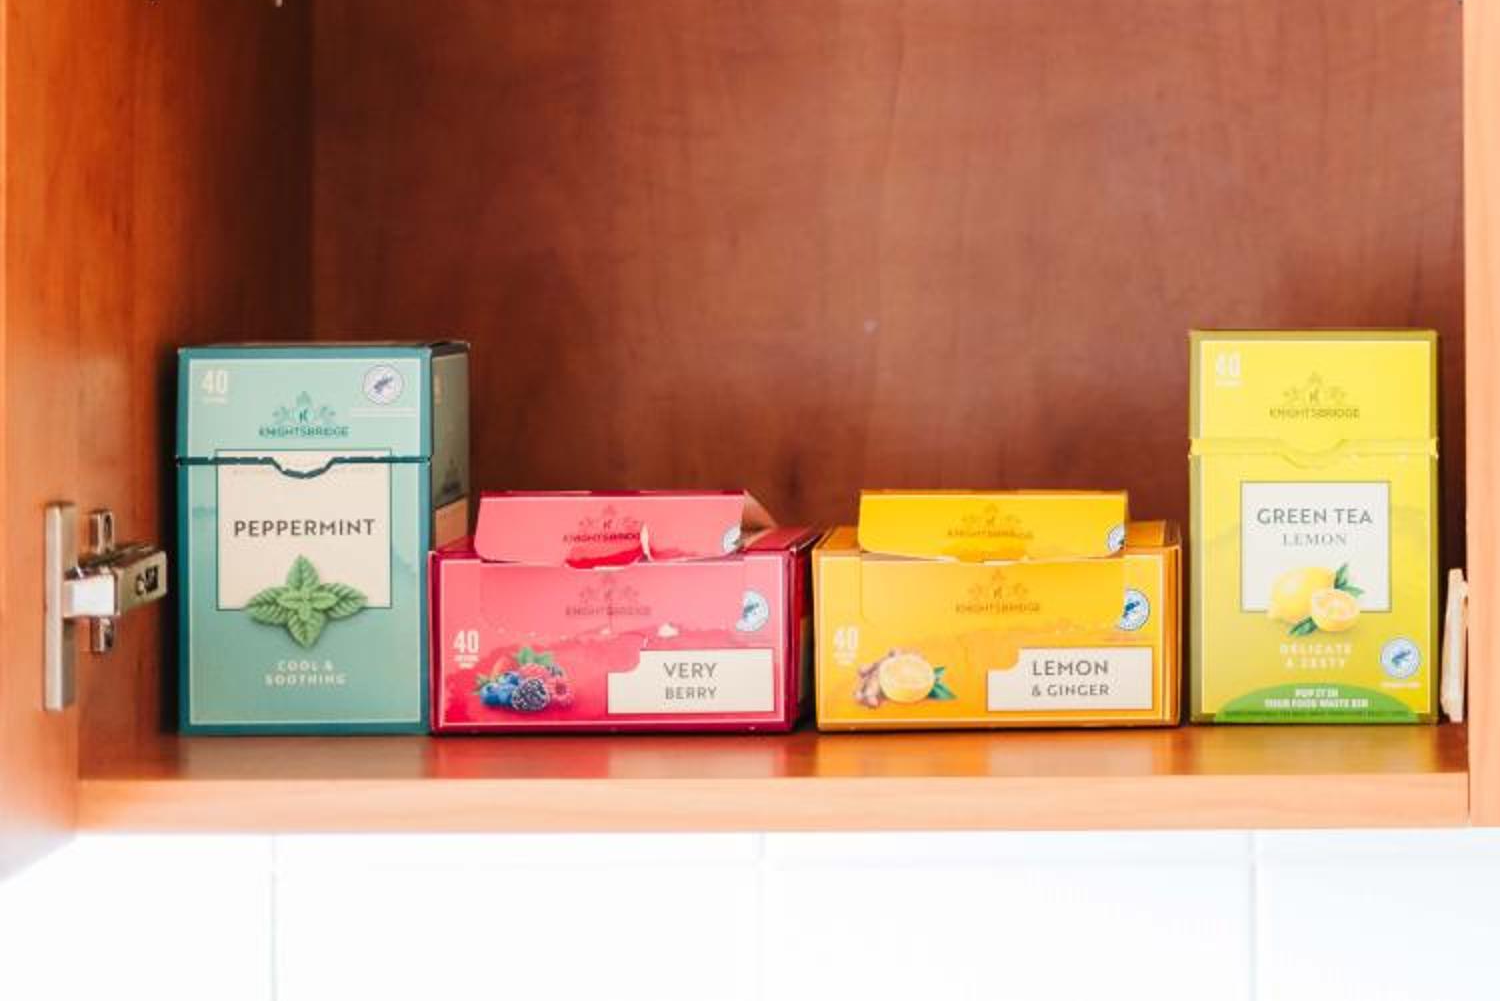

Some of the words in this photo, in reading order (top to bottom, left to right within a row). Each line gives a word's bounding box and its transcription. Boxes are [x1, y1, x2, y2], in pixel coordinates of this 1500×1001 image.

[201, 369, 228, 395] 40
[1269, 407, 1361, 419] KNIGHTSBRIDGE
[258, 425, 349, 438] KNIGHTSBRIDGE
[1256, 507, 1327, 525] GREEN
[1333, 507, 1374, 525] TEA
[233, 518, 377, 537] PEPPERMINT
[1282, 533, 1348, 548] LEMON
[453, 629, 480, 654] 40
[277, 659, 321, 672] COOL
[662, 661, 718, 679] VERY
[1031, 659, 1110, 676] LEMON
[263, 673, 347, 687] SOOTHING
[664, 685, 718, 700] BERRY
[1031, 683, 1042, 696] &
[1047, 683, 1110, 696] GINGER
